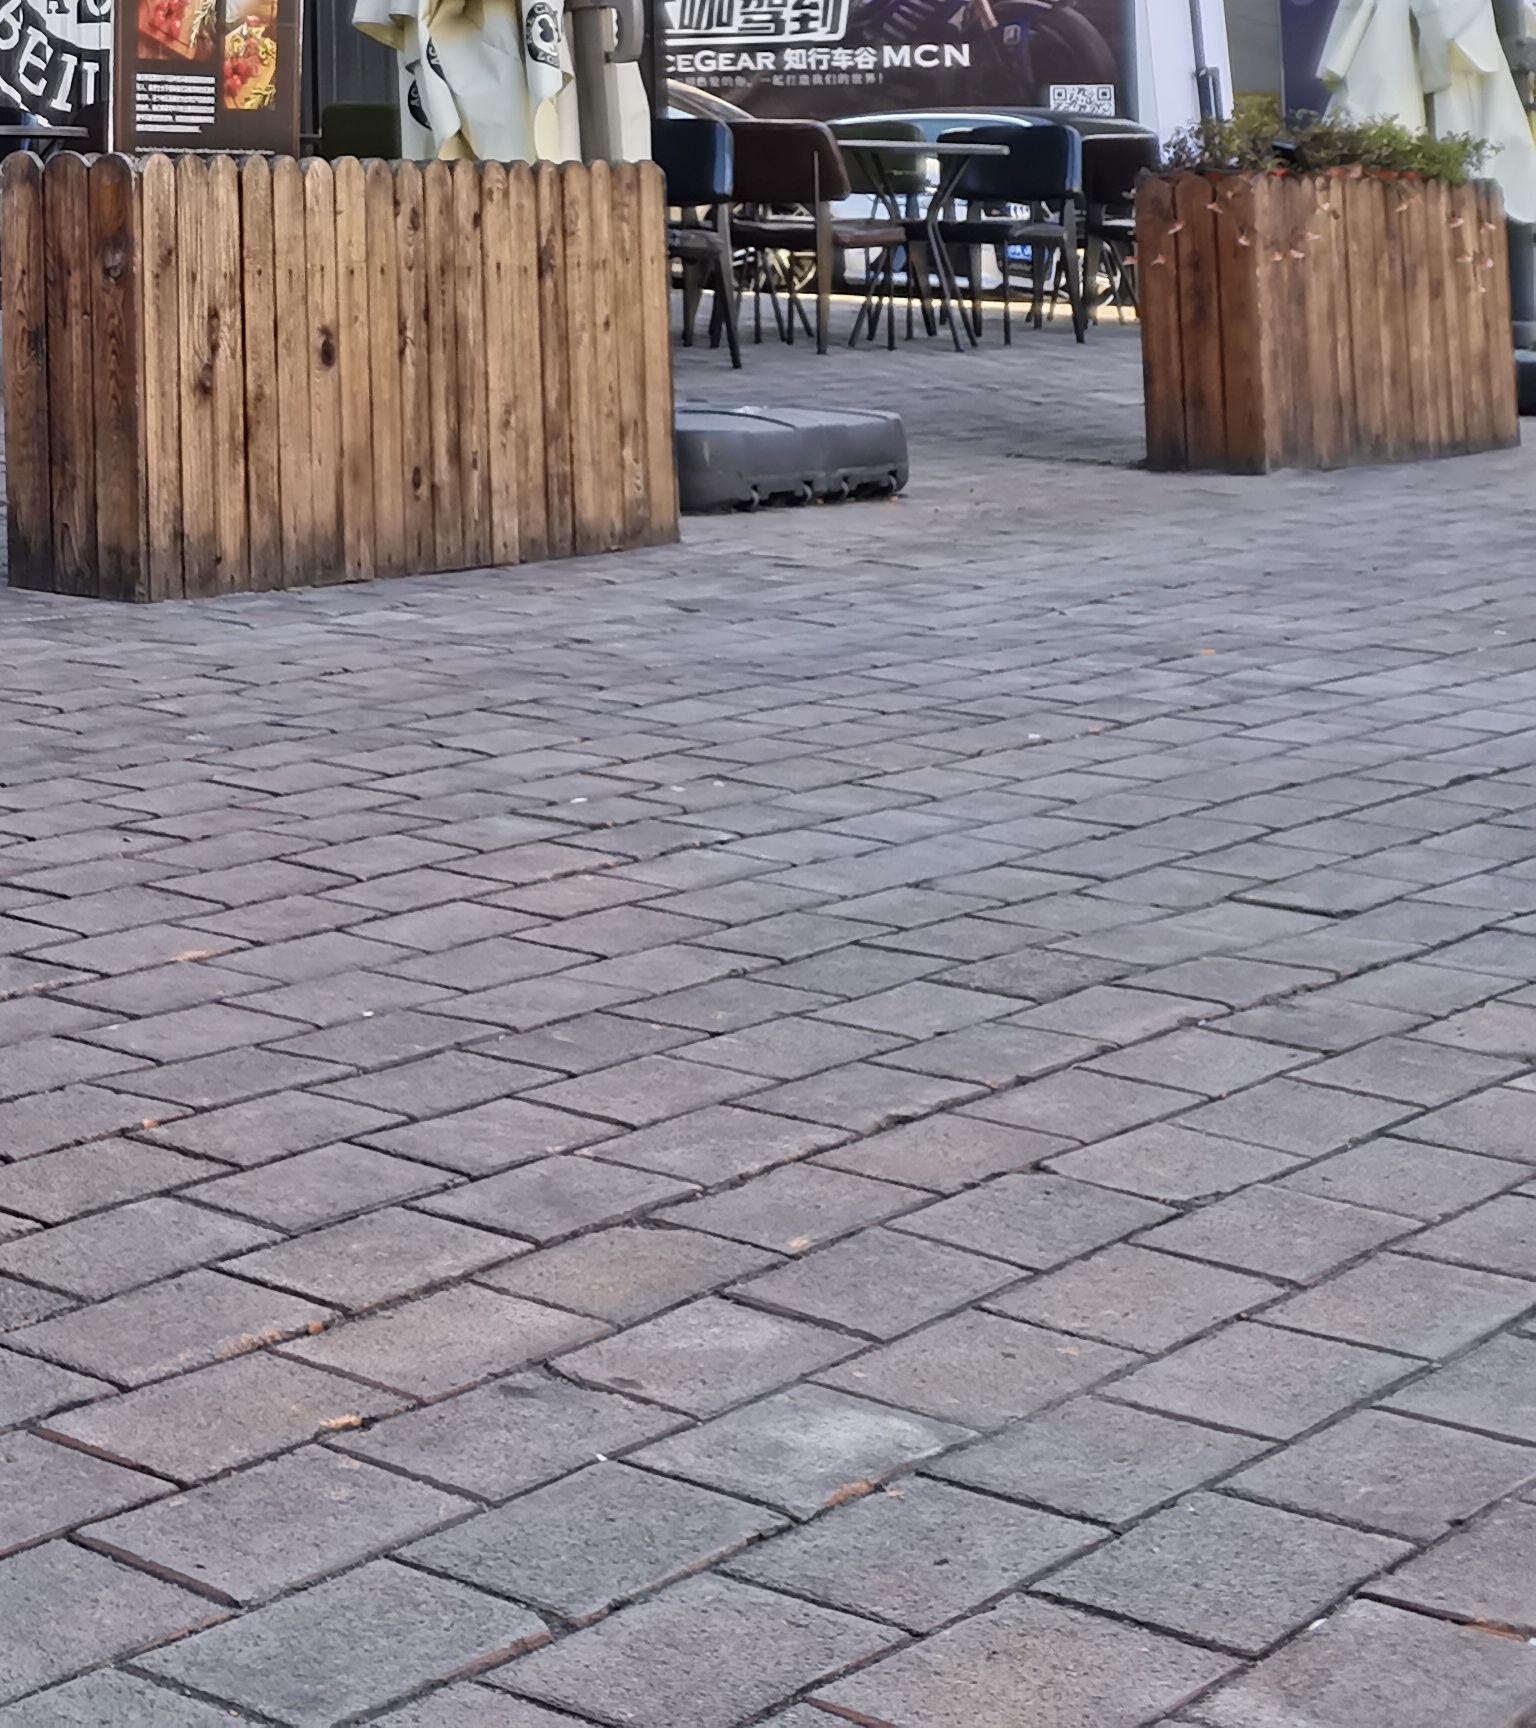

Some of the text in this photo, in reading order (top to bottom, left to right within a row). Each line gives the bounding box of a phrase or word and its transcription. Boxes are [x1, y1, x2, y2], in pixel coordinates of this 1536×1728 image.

[783, 47, 878, 71] 知行车谷
[883, 43, 971, 68] MCN
